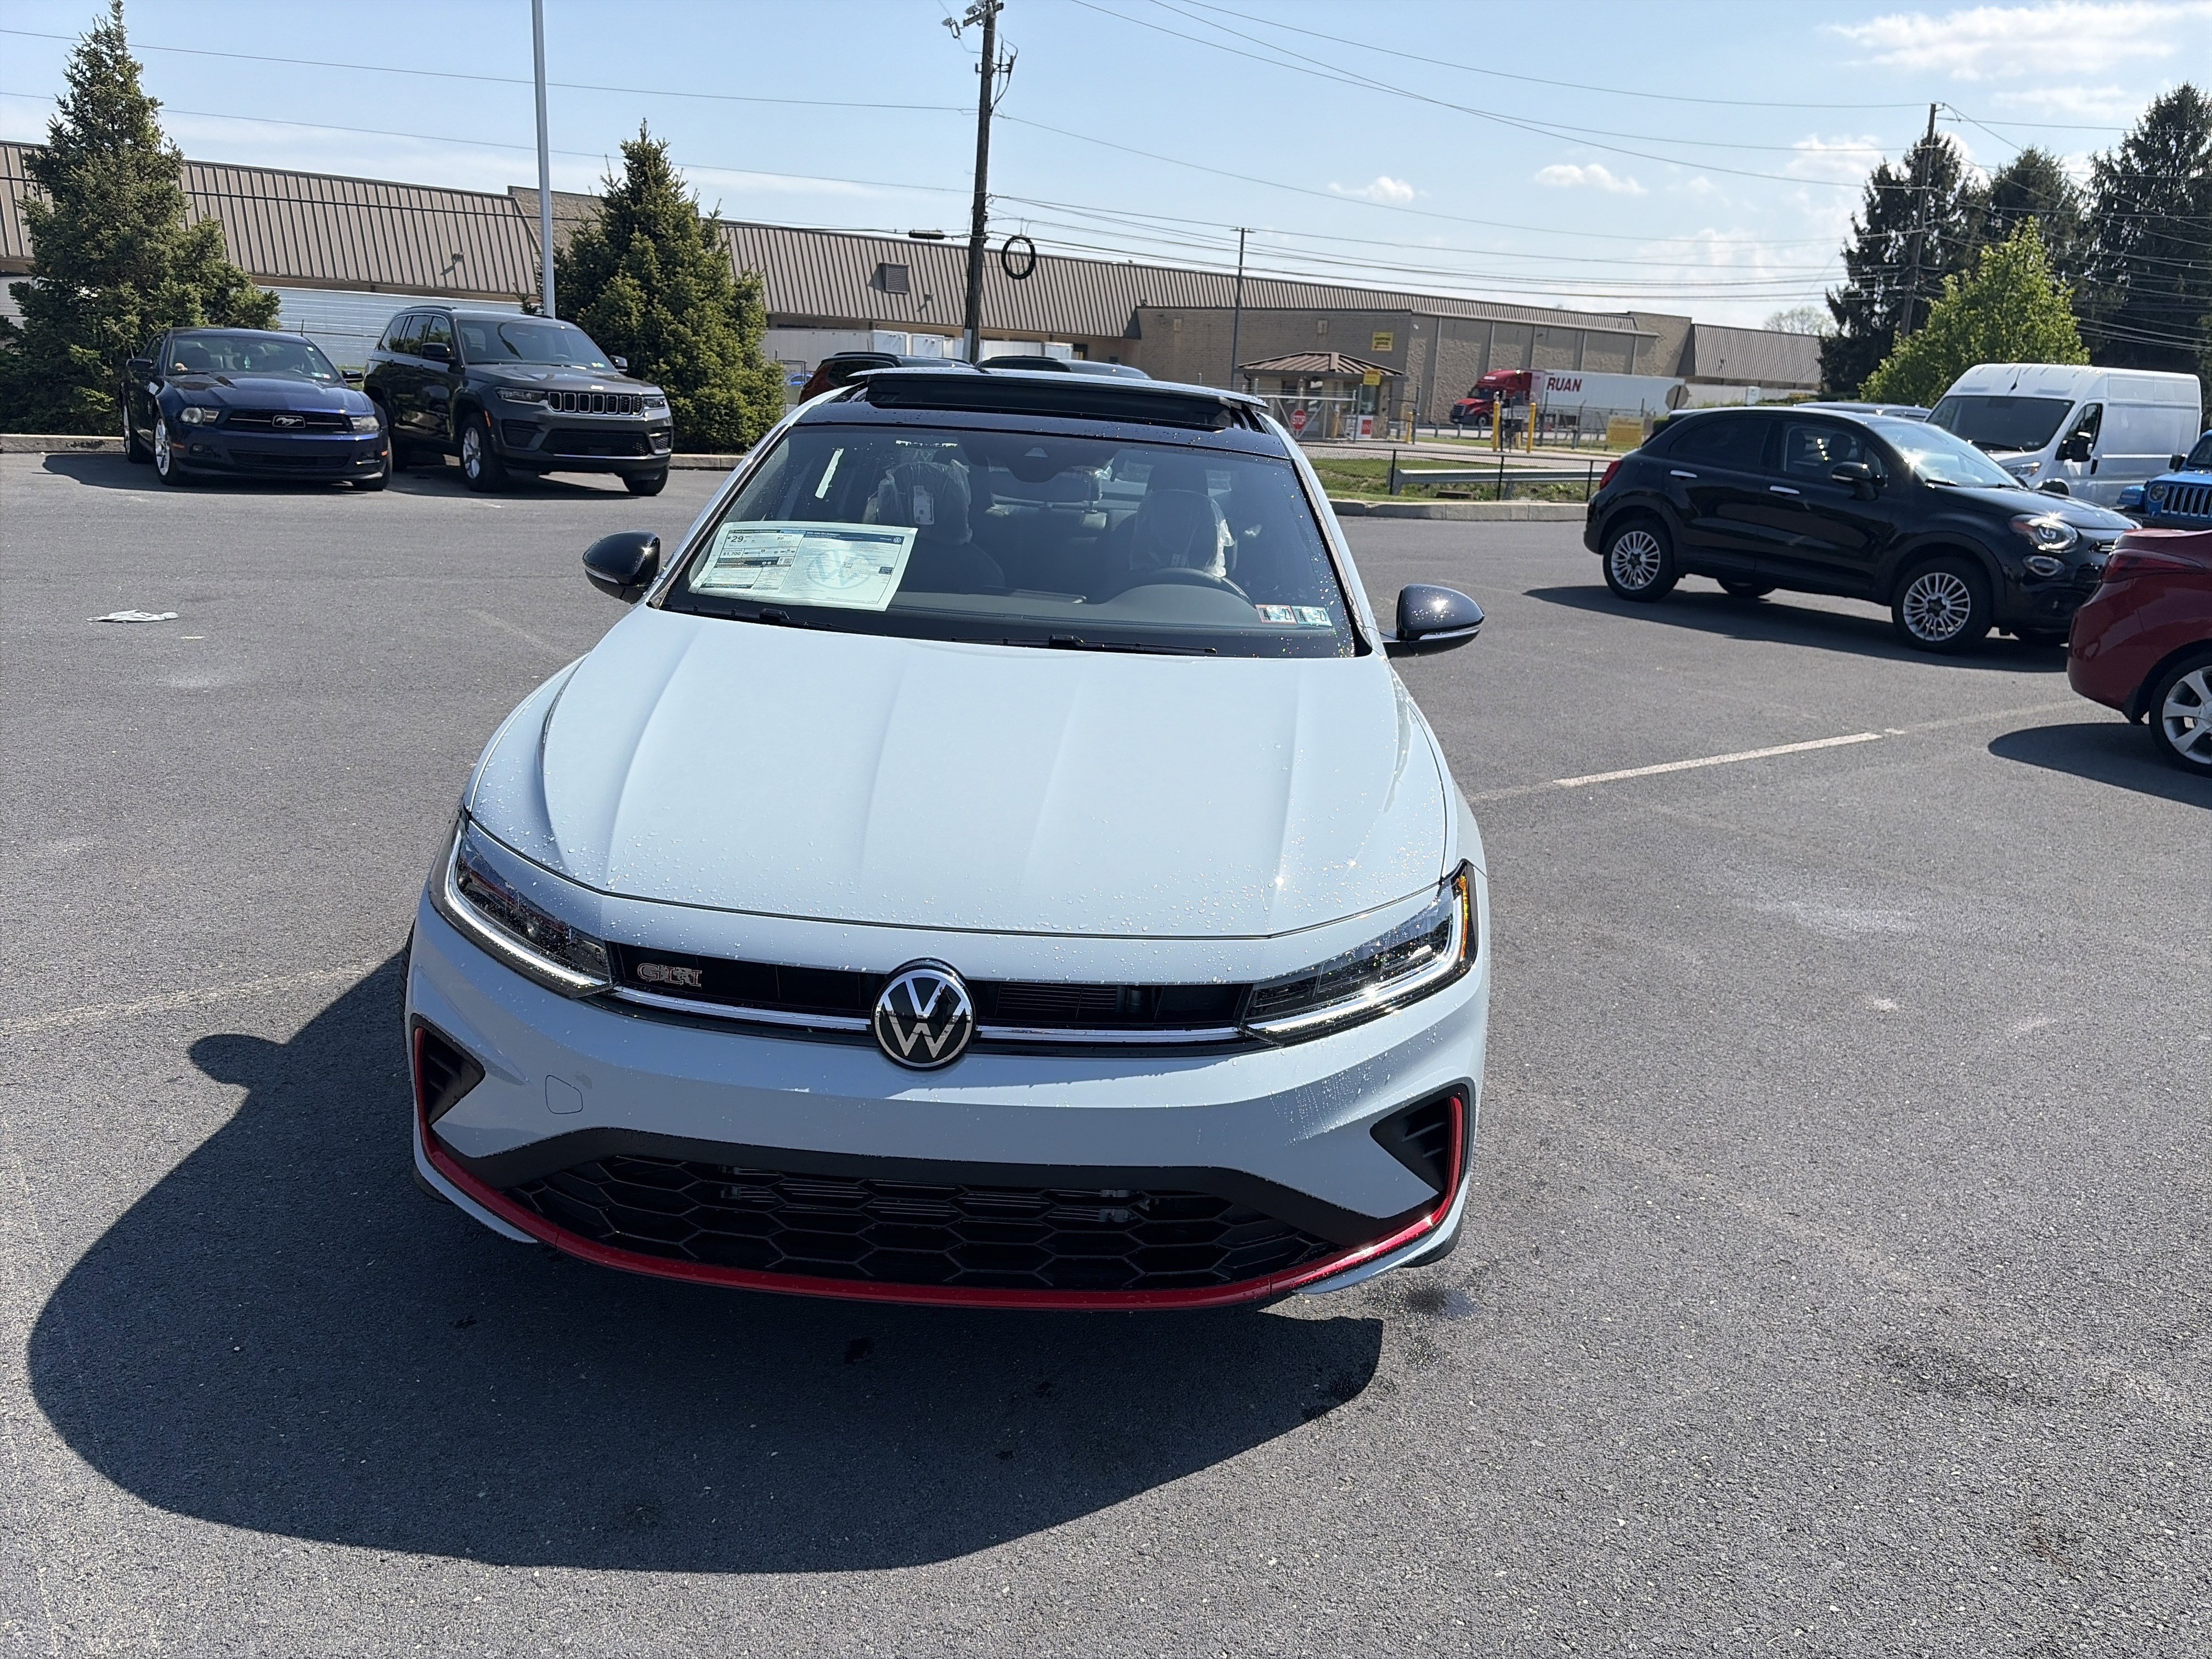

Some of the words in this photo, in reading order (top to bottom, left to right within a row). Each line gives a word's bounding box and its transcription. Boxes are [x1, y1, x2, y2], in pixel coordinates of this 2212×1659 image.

[1546, 377, 1582, 392] RUAN
[637, 963, 703, 988] GLI
[878, 970, 970, 1064] VW
